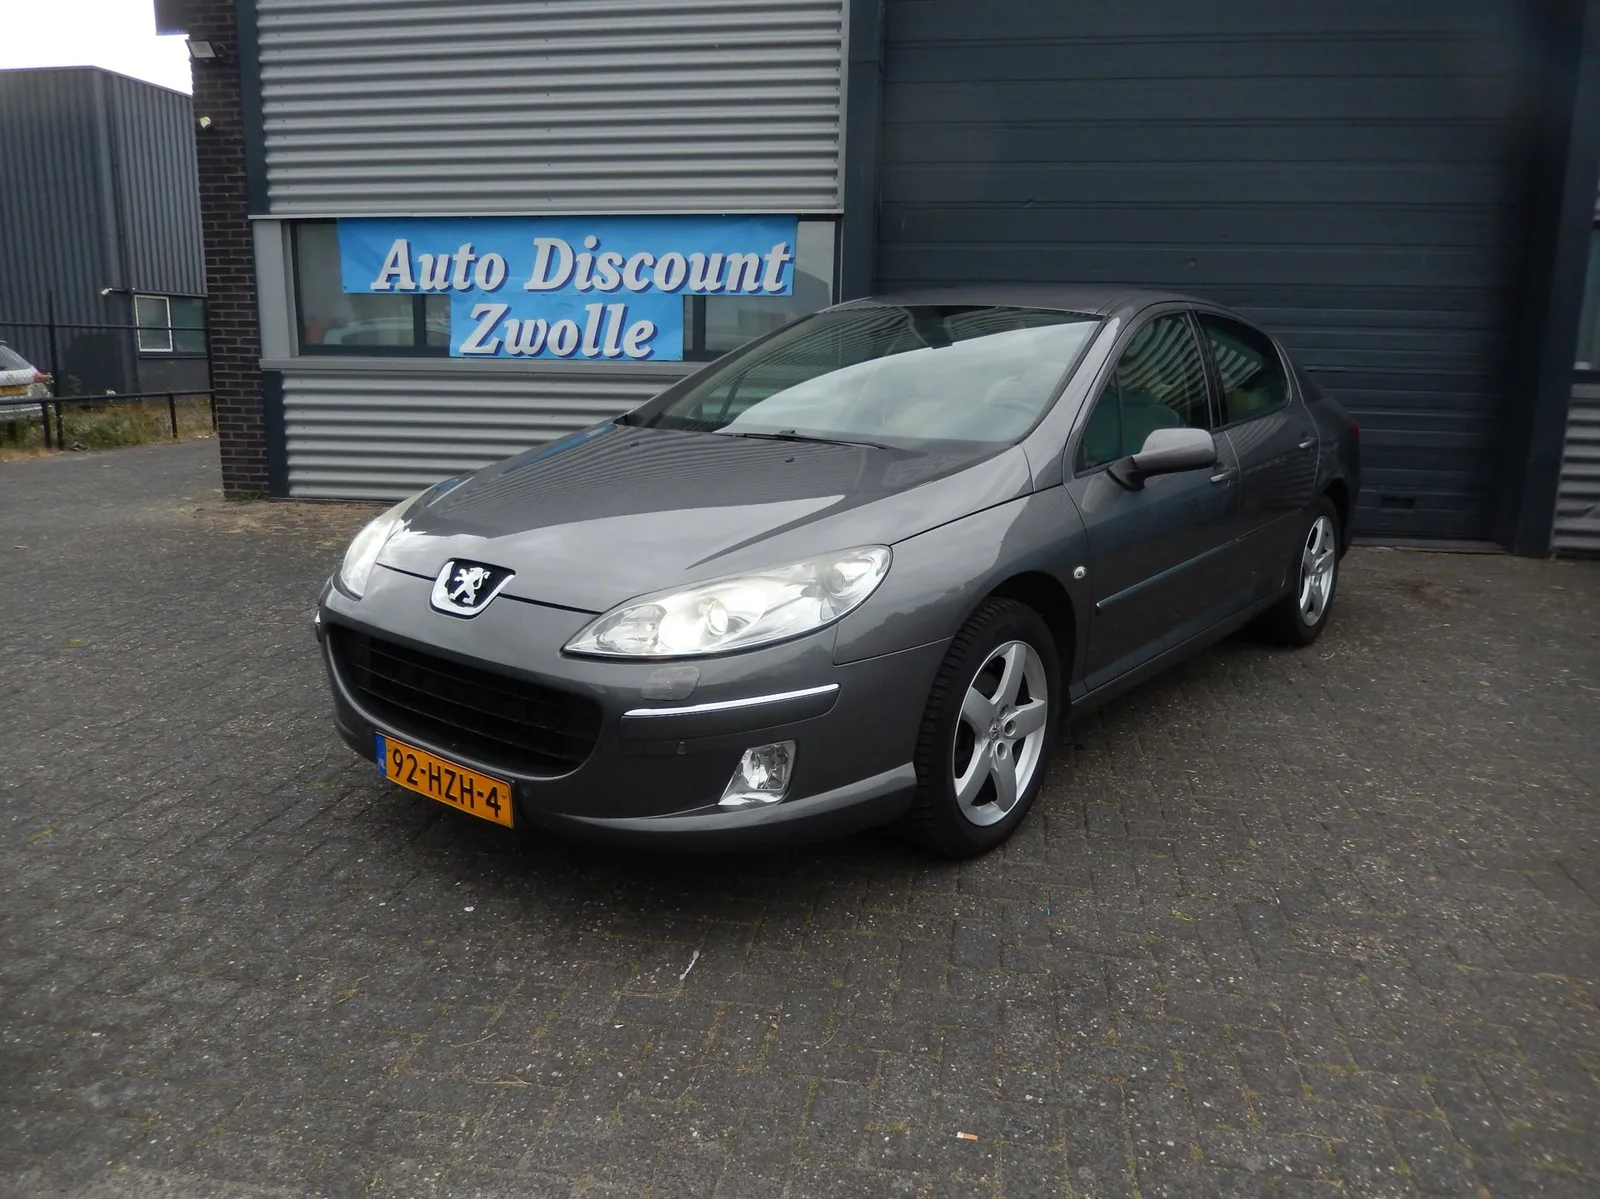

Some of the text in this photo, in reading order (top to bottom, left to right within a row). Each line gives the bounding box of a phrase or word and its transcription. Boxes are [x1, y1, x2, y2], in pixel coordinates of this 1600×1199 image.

[371, 235, 794, 295] Auto Discount
[460, 302, 658, 360] Zwolle
[392, 748, 501, 818] 92-HZH-4
